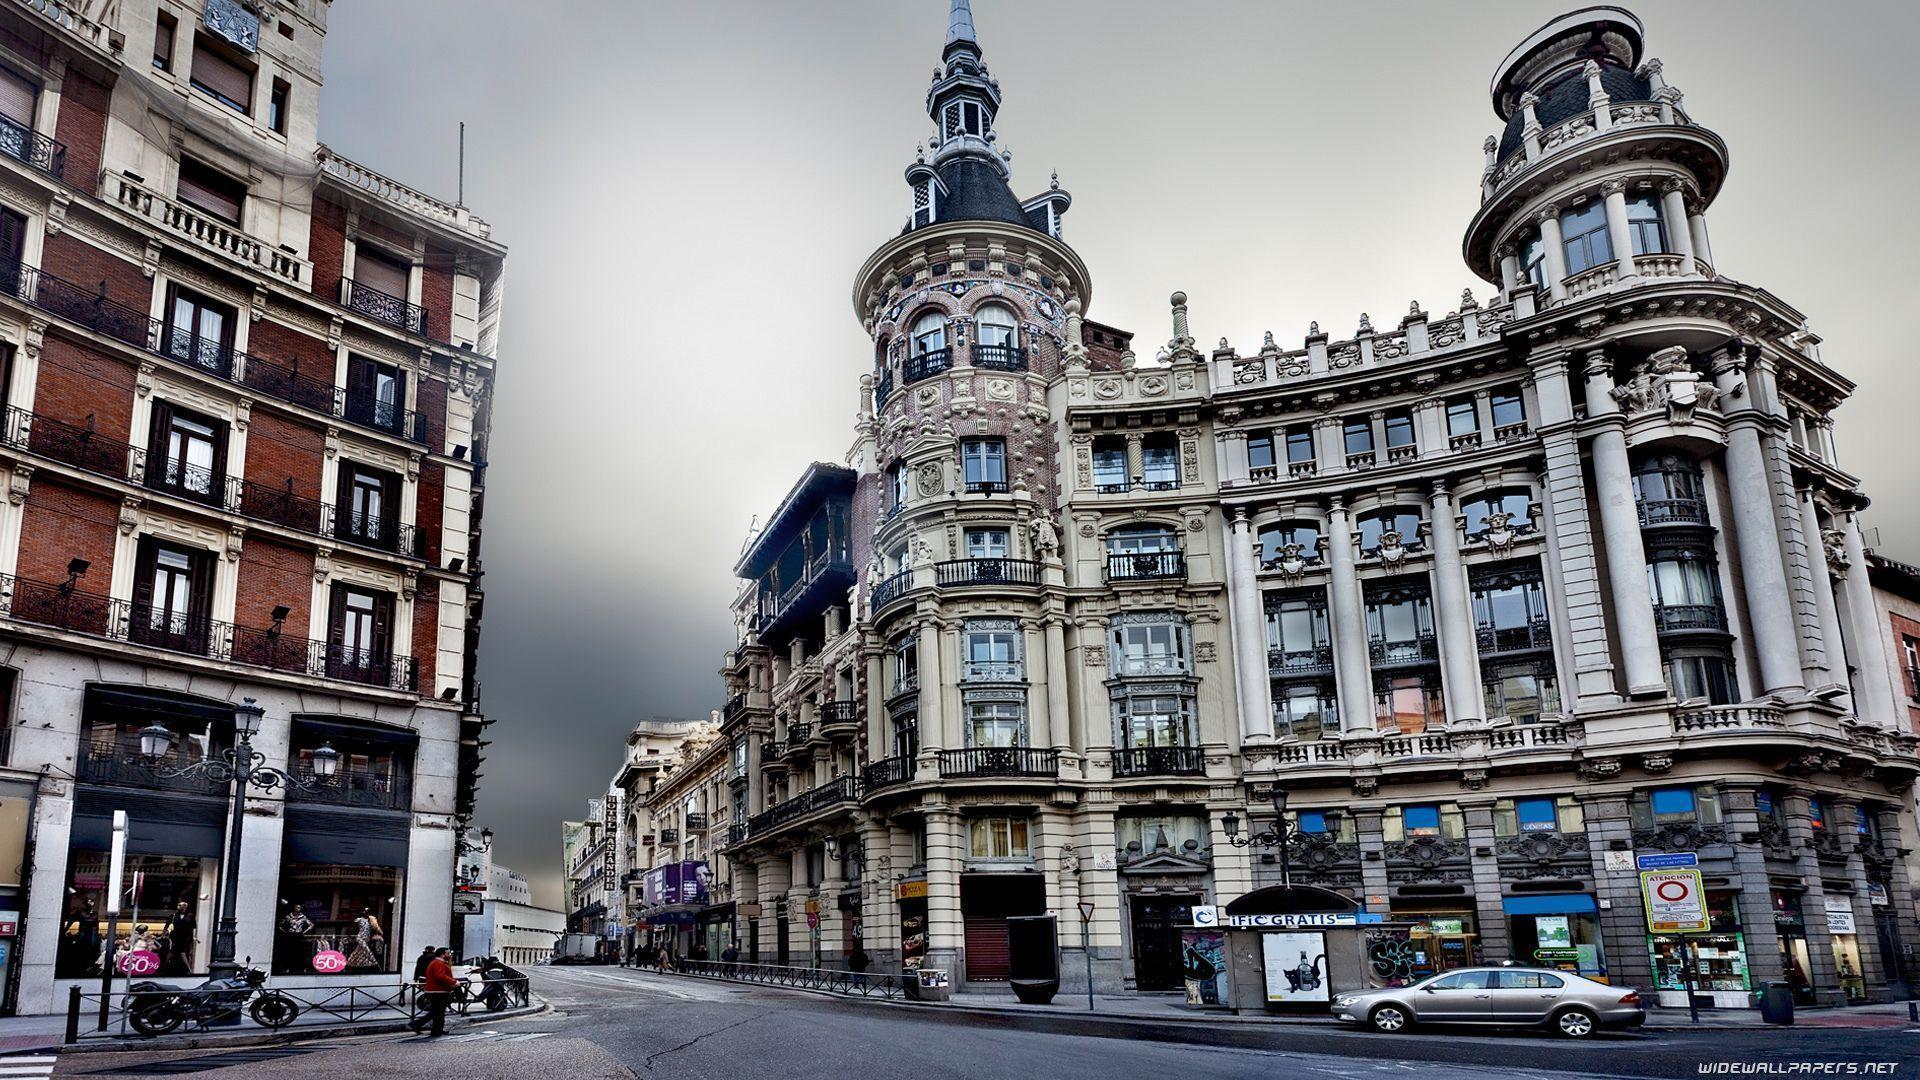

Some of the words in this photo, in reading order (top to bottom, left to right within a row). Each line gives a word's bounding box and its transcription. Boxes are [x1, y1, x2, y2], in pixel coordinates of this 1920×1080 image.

[606, 795, 616, 829] HOTEL
[604, 831, 616, 890] SANTANDER
[1271, 914, 1336, 926] GRATIS
[316, 956, 346, 970] 50%
